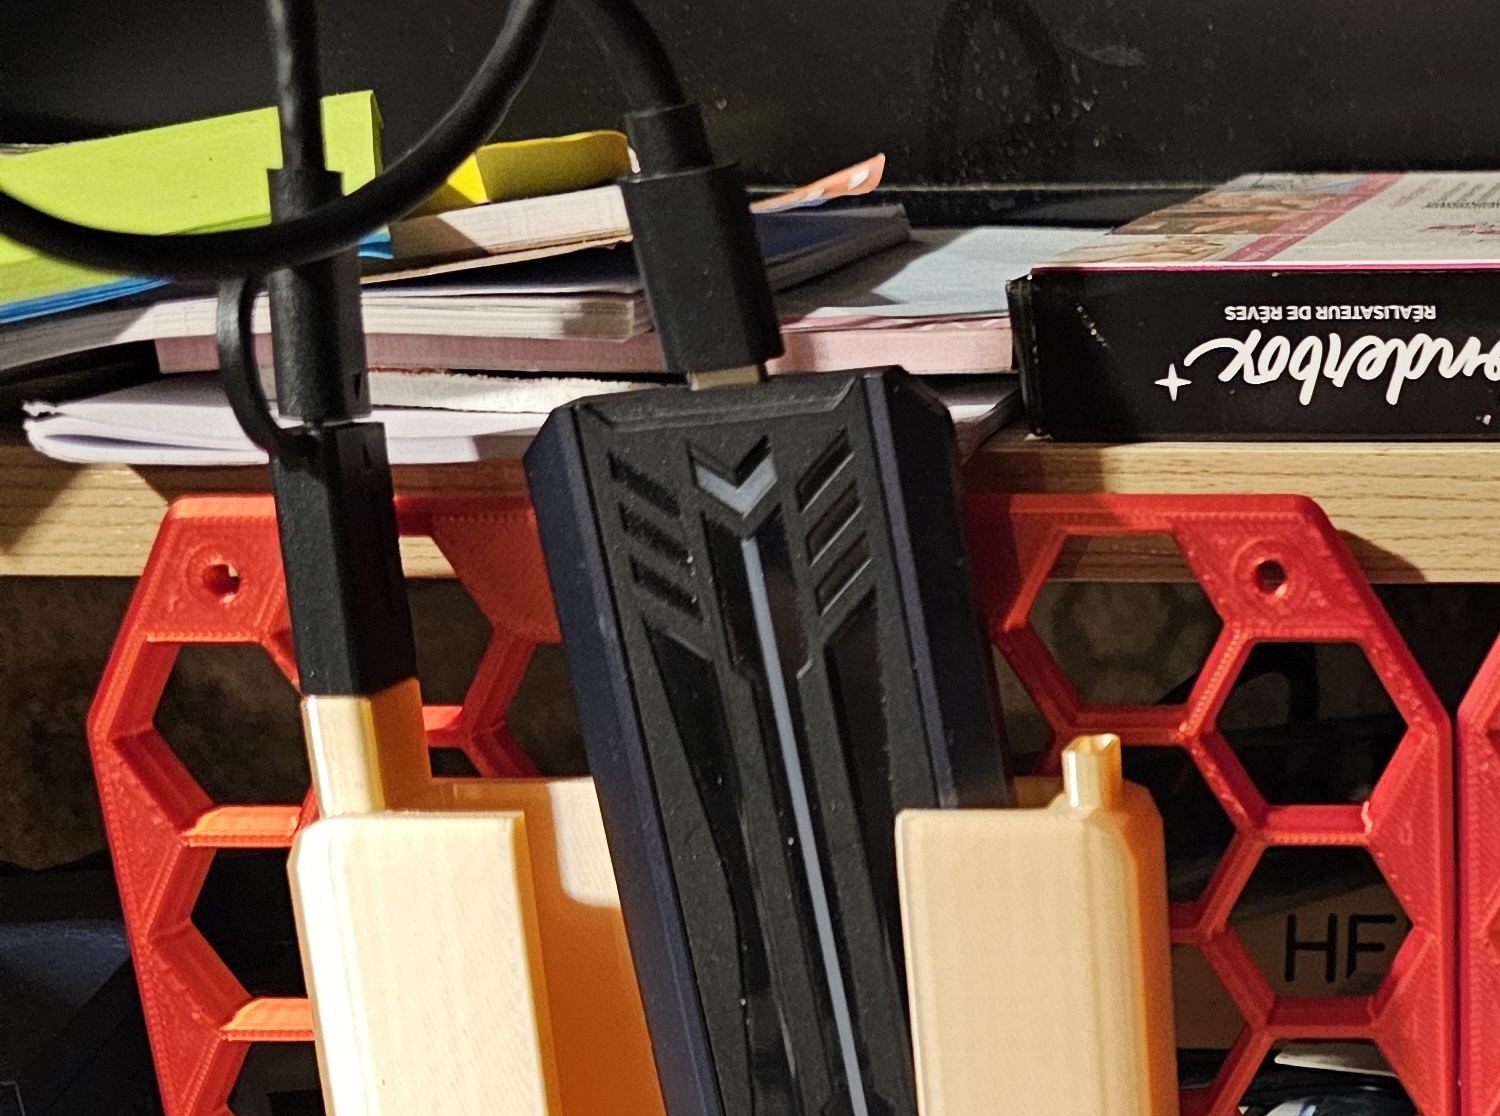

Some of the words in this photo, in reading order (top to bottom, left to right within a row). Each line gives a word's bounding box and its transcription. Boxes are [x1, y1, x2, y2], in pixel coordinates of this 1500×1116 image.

[1224, 306, 1283, 324] RÊVES
[1286, 306, 1311, 321] DE
[1316, 305, 1436, 323] RÉALISATEUR
